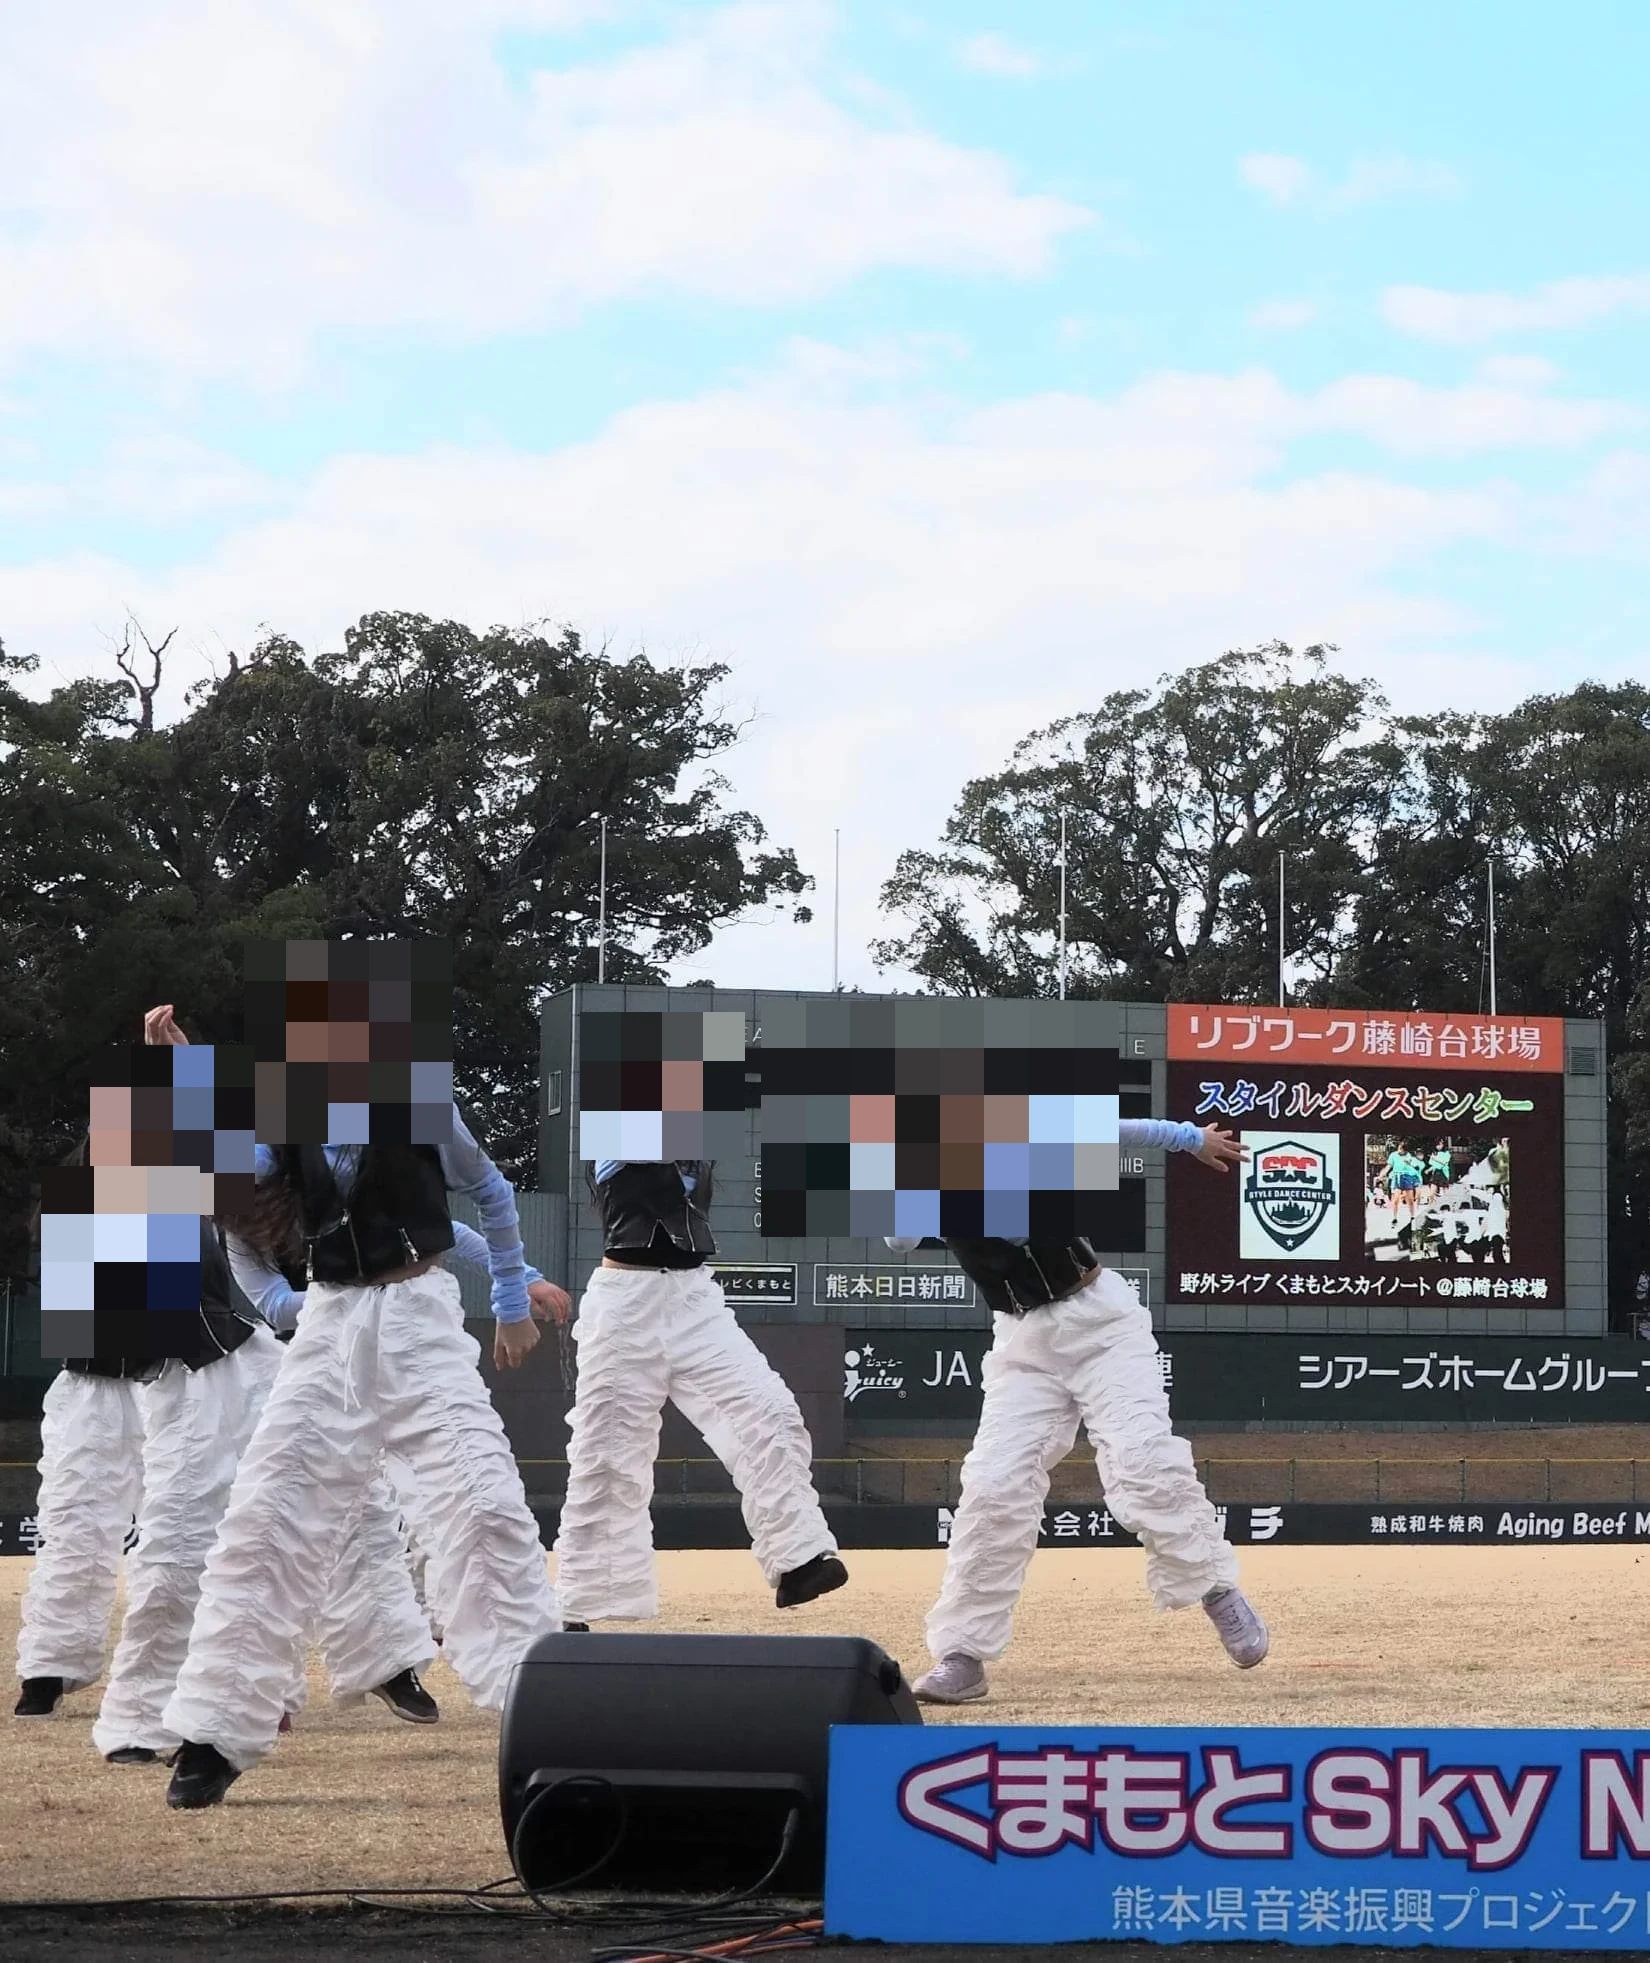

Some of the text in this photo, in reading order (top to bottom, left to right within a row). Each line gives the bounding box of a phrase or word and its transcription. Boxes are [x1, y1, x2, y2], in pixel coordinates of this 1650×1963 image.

[1134, 1040, 1145, 1055] E
[1190, 1015, 1542, 1061] リブワーク藤崎台球場
[1195, 1080, 1535, 1124] スタイルダンスセンター
[1249, 1190, 1332, 1200] STYLE DANCE CENTER
[825, 1273, 966, 1300] 熊本日日新聞
[1180, 1272, 1549, 1299] 野外ライブ くまもとスカイノート @藤崎台球場
[922, 1350, 972, 1386] JA
[1040, 1510, 1115, 1537] 会社
[1370, 1515, 1484, 1534] 熟成和牛焼肉
[1496, 1511, 1564, 1538] Aging
[1572, 1512, 1627, 1536] Beef
[901, 1743, 1295, 1864] くまもと
[1303, 1747, 1561, 1874] Sky
[1111, 1884, 1650, 1934] 熊本県音楽振興プロジェク
